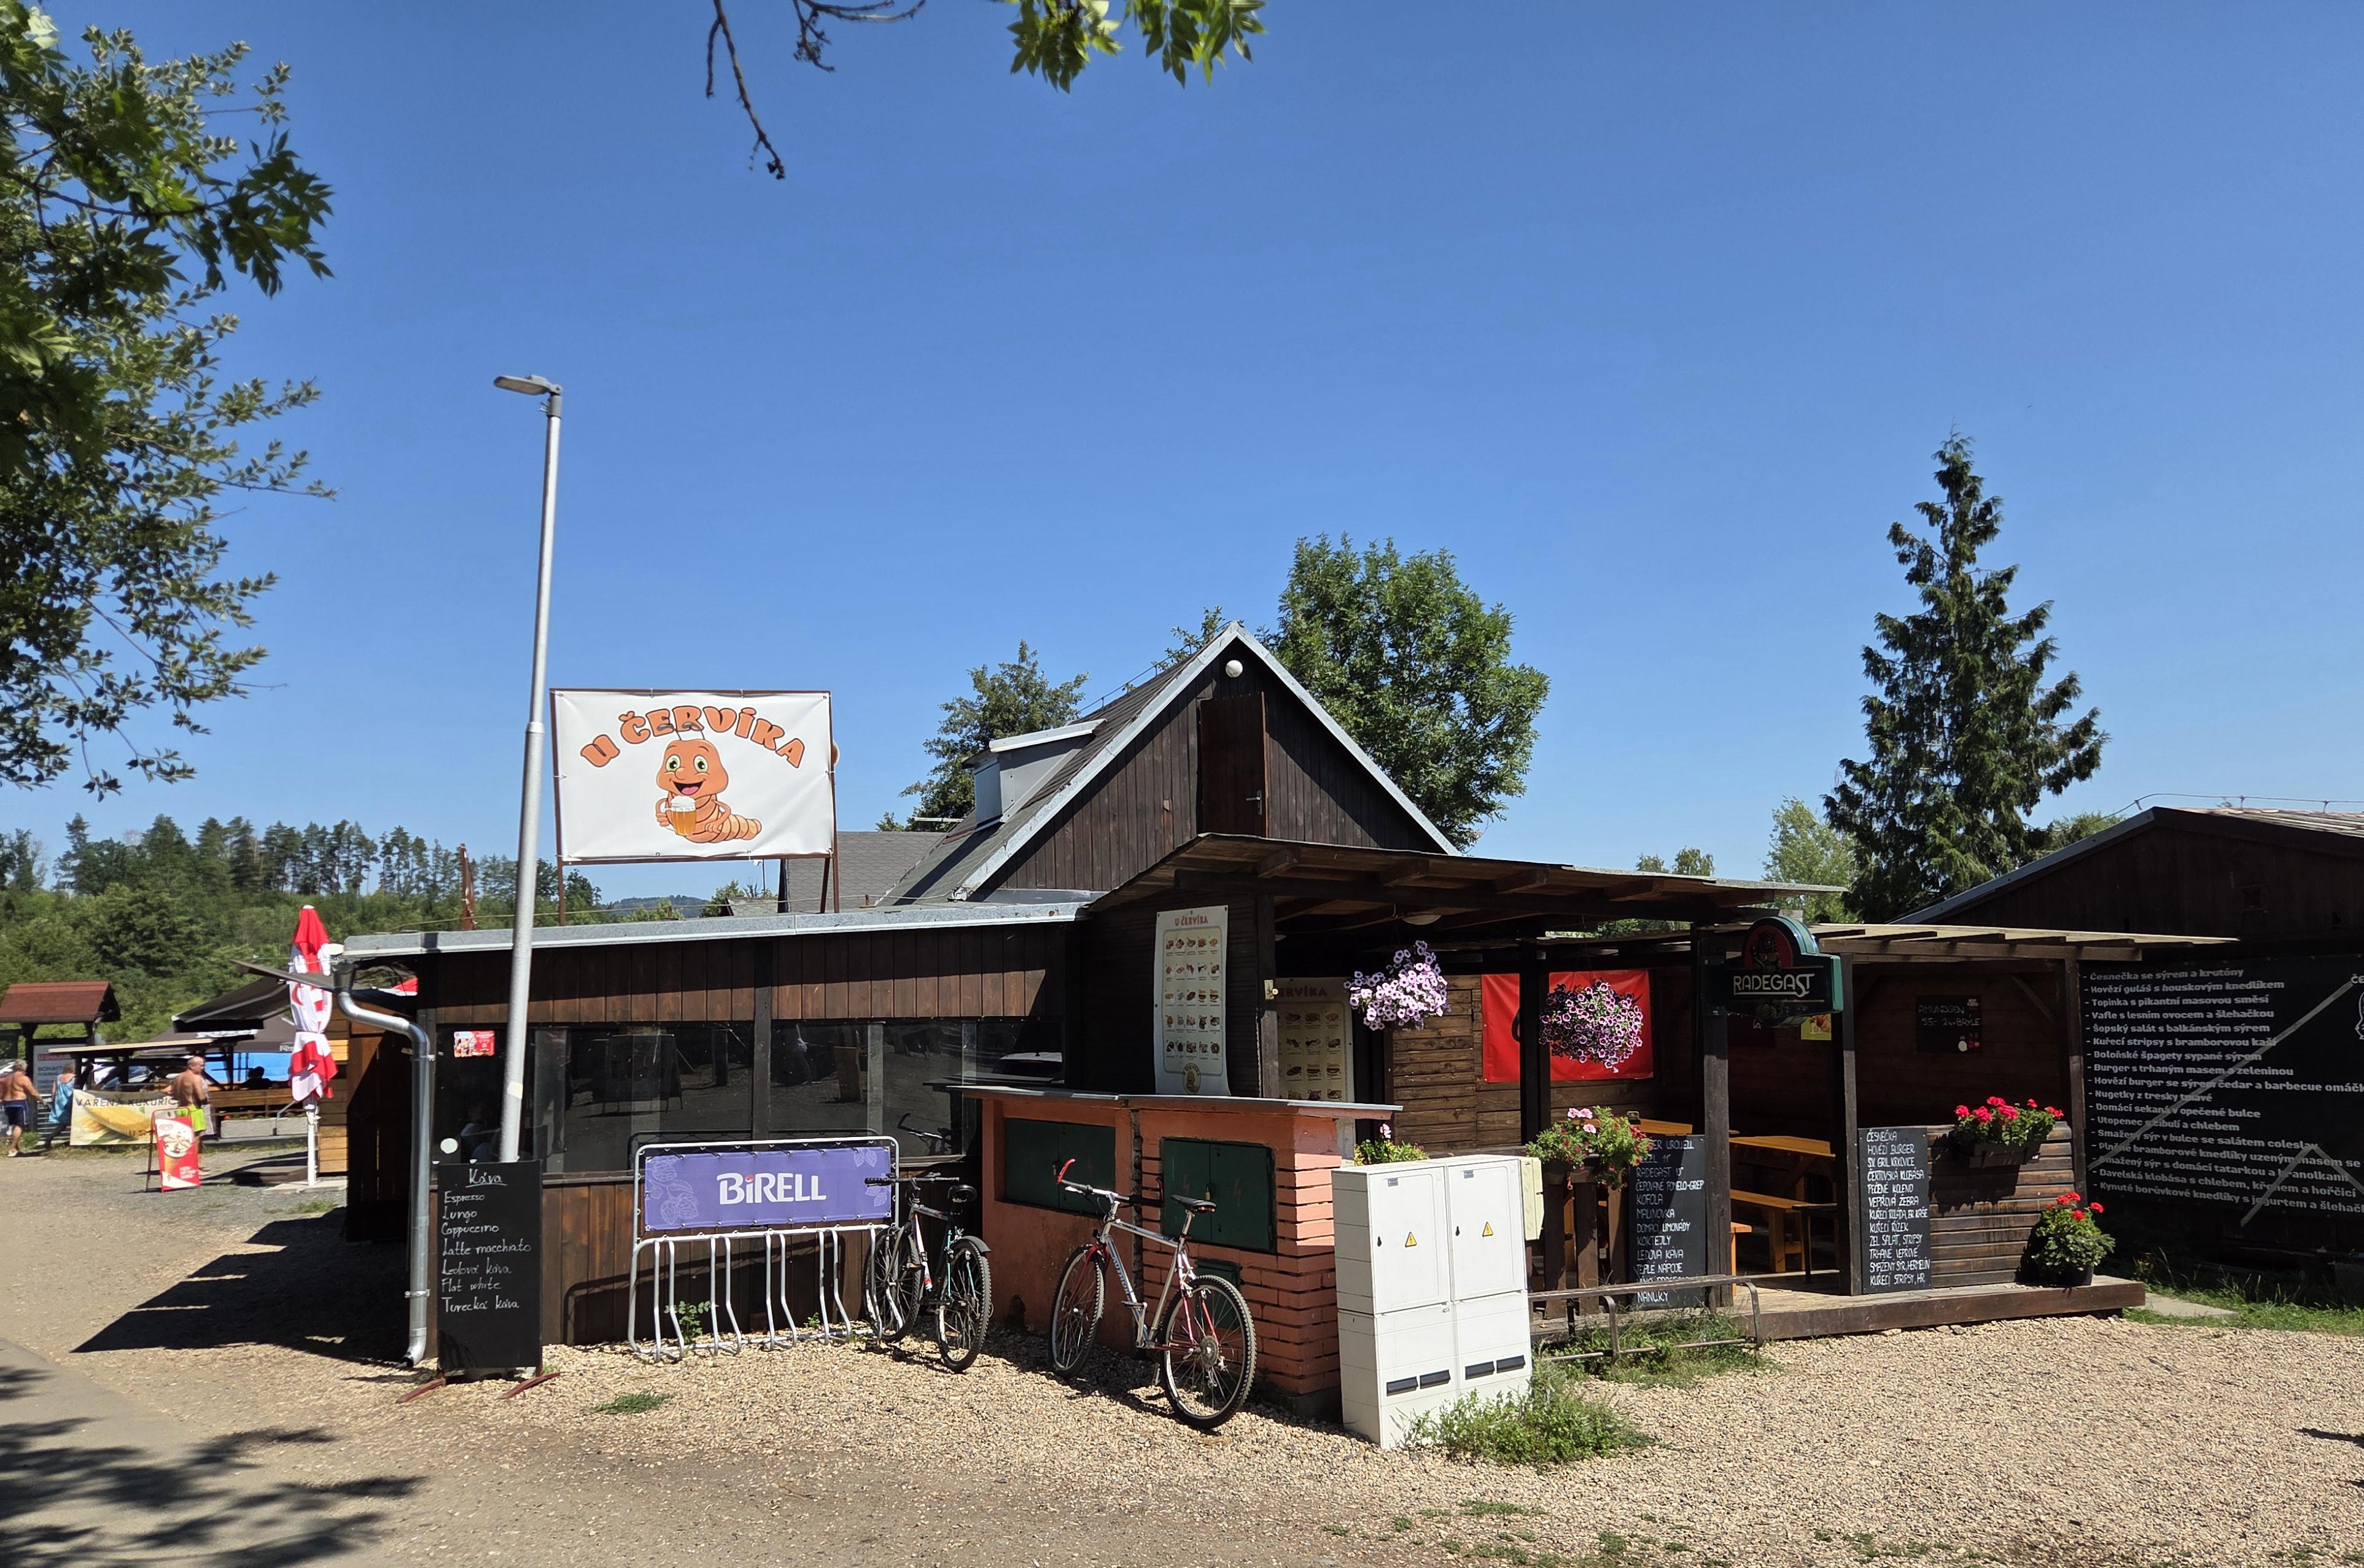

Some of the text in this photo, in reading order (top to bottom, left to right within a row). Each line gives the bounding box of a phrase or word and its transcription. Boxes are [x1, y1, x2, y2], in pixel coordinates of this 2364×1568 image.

[580, 705, 806, 769] U ČERVÍKA
[2090, 971, 2139, 980] Česnečka
[2156, 971, 2188, 980] sýrem
[2199, 968, 2244, 977] krutóny
[1278, 985, 1328, 998] ERVÍKA
[1733, 973, 1814, 998] RADEGAST
[2124, 984, 2151, 994] guláš
[2162, 982, 2223, 992] houskovým
[2225, 980, 2284, 990] knedlíkem
[2091, 998, 2128, 1007] Topinka
[2139, 996, 2180, 1007] pikantní
[2234, 995, 2269, 1004] směsí
[2127, 1011, 2160, 1019] lesním
[2215, 1009, 2274, 1019] šlehačkou
[2093, 1023, 2128, 1034] Šopský
[2166, 1023, 2231, 1034] balkánským
[2234, 1023, 2270, 1034] sýrem
[2127, 1038, 2164, 1047] stripsy
[2140, 1051, 2182, 1061] špagety
[2184, 1052, 2223, 1061] sypané
[2225, 1052, 2262, 1062] sýrem
[2094, 1064, 2129, 1073] Burger
[2139, 1065, 2183, 1074] trhaným
[2236, 1066, 2294, 1076] zeleninou
[2094, 1077, 2127, 1085] Hovězí
[2129, 1077, 2164, 1087] burger
[2182, 1079, 2215, 1089] sýrem
[2218, 1079, 2253, 1089] čedar
[2265, 1081, 2322, 1091] barbecue
[2095, 1090, 2134, 1100] Nugetky
[2144, 1092, 2178, 1101] tresky
[2096, 1103, 2132, 1112] Domácí
[2180, 1107, 2226, 1117] opečené
[2228, 1108, 2261, 1118] bulce
[2098, 1116, 2142, 1126] Utopenec
[2153, 1120, 2180, 1128] cibulí
[2190, 1121, 2240, 1131] chlebem
[1867, 1129, 1897, 1142] ČESNEČKA
[2143, 1132, 2160, 1141] sýr
[2169, 1133, 2199, 1143] bulce
[2217, 1136, 2265, 1147] salátem
[1867, 1142, 1915, 1155] HOVĚZÍ BURGER
[2133, 1144, 2197, 1157] bramborové
[2199, 1149, 2247, 1162] knedlíky
[2250, 1153, 2295, 1164] uzeným
[1636, 1166, 1672, 1178] RADEGAST
[1867, 1166, 1924, 1181] ČERTOVSKÁ KLOBÁSA
[2144, 1159, 2161, 1169] sýr
[2172, 1161, 2212, 1171] domácí
[2214, 1165, 2266, 1176] tatarkou
[469, 1168, 502, 1184] Káva
[2099, 1168, 2143, 1179] Davelská
[2145, 1172, 2187, 1183] klobása
[2198, 1177, 2250, 1190] chlebem,
[2311, 1186, 2356, 1197] hořčicí
[1636, 1179, 1665, 1191] ČEPOVANÉ
[1867, 1181, 1913, 1194] PEČENÉ KOLENO
[444, 1190, 485, 1206] Espresso
[1636, 1193, 1663, 1205] KOFOLA
[2100, 1182, 2133, 1192] Kynuté
[2135, 1184, 2191, 1198] borůvkové
[2193, 1190, 2241, 1203] knedlíky
[1868, 1193, 1919, 1207] VEPŘOVÁ ŽEBRA
[442, 1206, 477, 1223] Lungo
[1636, 1209, 1675, 1219] MALINOVKA
[1869, 1207, 1888, 1220] KUŘECÍ
[1636, 1219, 1690, 1233] DOMÁCÍ LIMONÁDY
[1870, 1221, 1909, 1233] KUŘECÍ ŘÍZEK
[442, 1238, 532, 1256] Latte macchiato
[1636, 1235, 1671, 1246] KOKTEJLY
[1637, 1246, 1684, 1260] LEDOVÁ KÁVA
[1895, 1244, 1919, 1258] VEPŘOVÉ
[441, 1259, 479, 1275] Ledová
[1636, 1260, 1683, 1275] TEPLÉ NÁPOJE
[1870, 1259, 1895, 1273] SMAŽENÝ
[441, 1276, 502, 1292] Flat white
[1870, 1272, 1892, 1286] KUŘECÍ
[1637, 1291, 1668, 1303] NANUKY
[441, 1296, 488, 1313] Turecká
